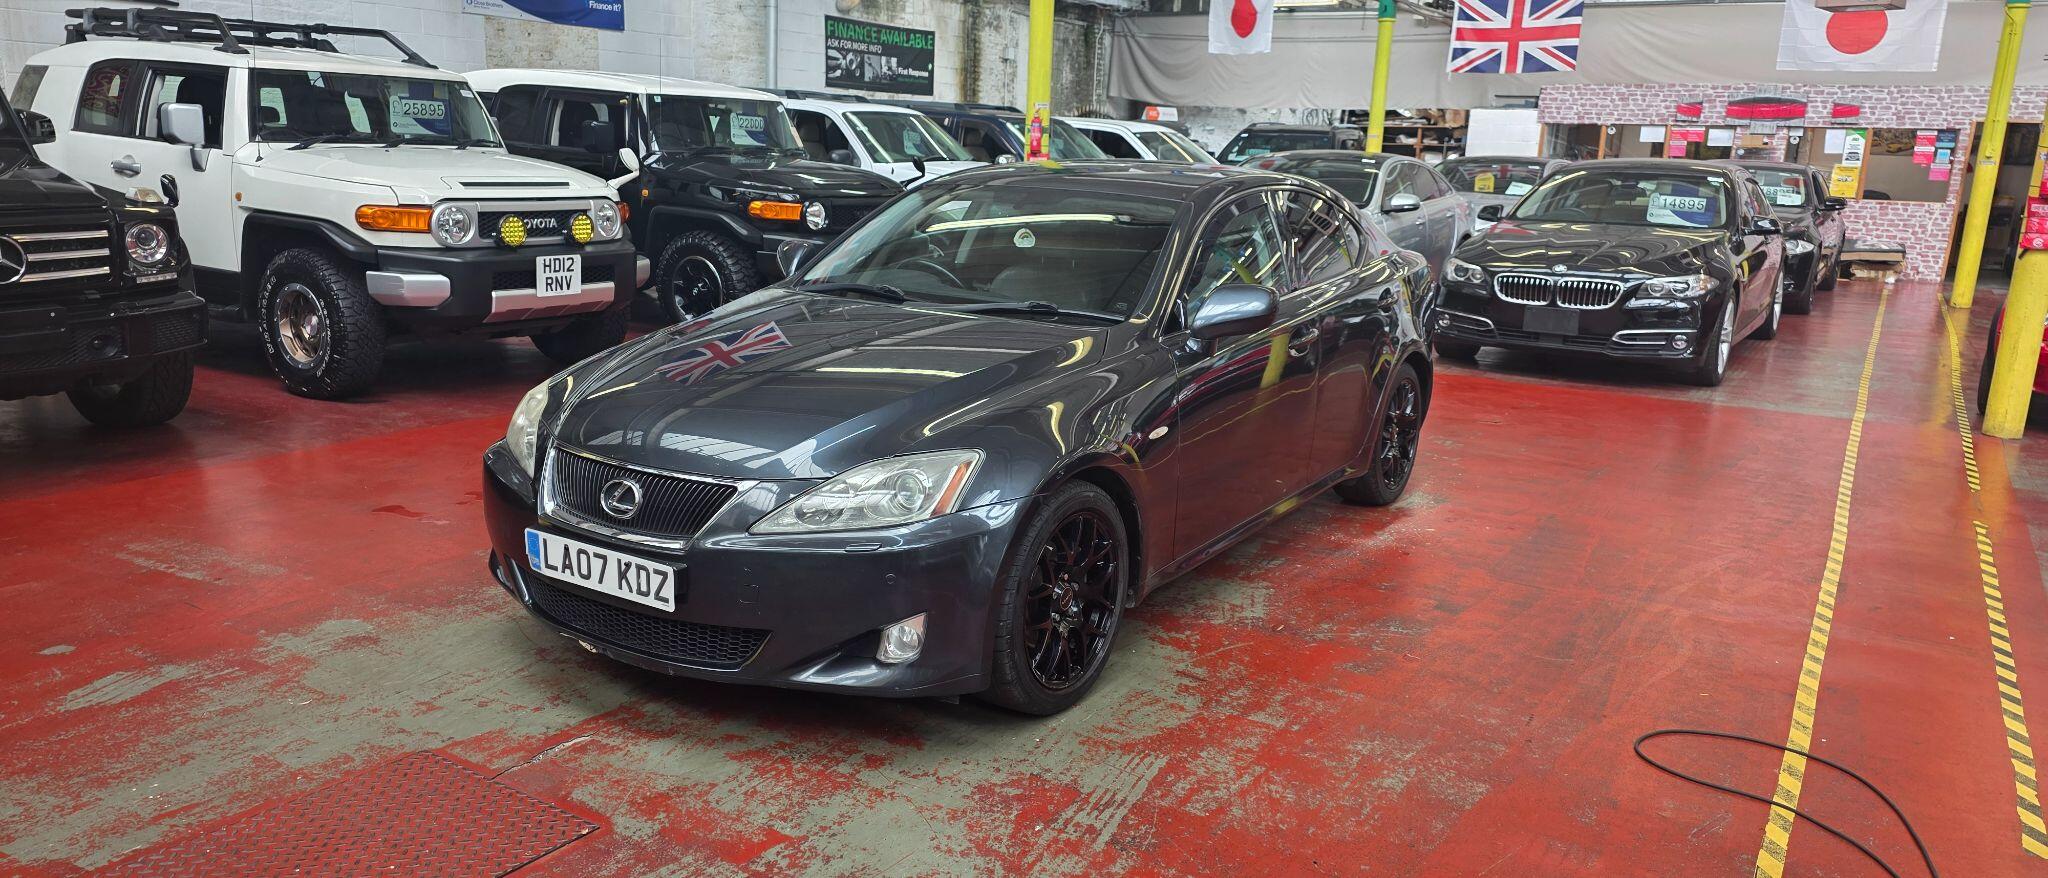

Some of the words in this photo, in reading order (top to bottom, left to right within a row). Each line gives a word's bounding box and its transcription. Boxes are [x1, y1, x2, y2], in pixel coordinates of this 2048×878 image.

[589, 0, 613, 11] Finance
[613, 3, 622, 12] it?
[826, 20, 878, 43] FINANCE
[879, 28, 934, 50] AVAILABLE
[827, 38, 839, 48] ASK
[840, 39, 852, 49] FOR
[852, 41, 868, 52] MORE
[868, 44, 883, 54] INFO
[403, 102, 444, 117] 25895
[1662, 198, 1705, 211] 14895
[525, 217, 558, 229] OYOTA
[543, 256, 575, 274] HD12
[545, 275, 573, 292] RNV
[542, 537, 608, 585] LA07
[616, 557, 670, 604] KDZ
